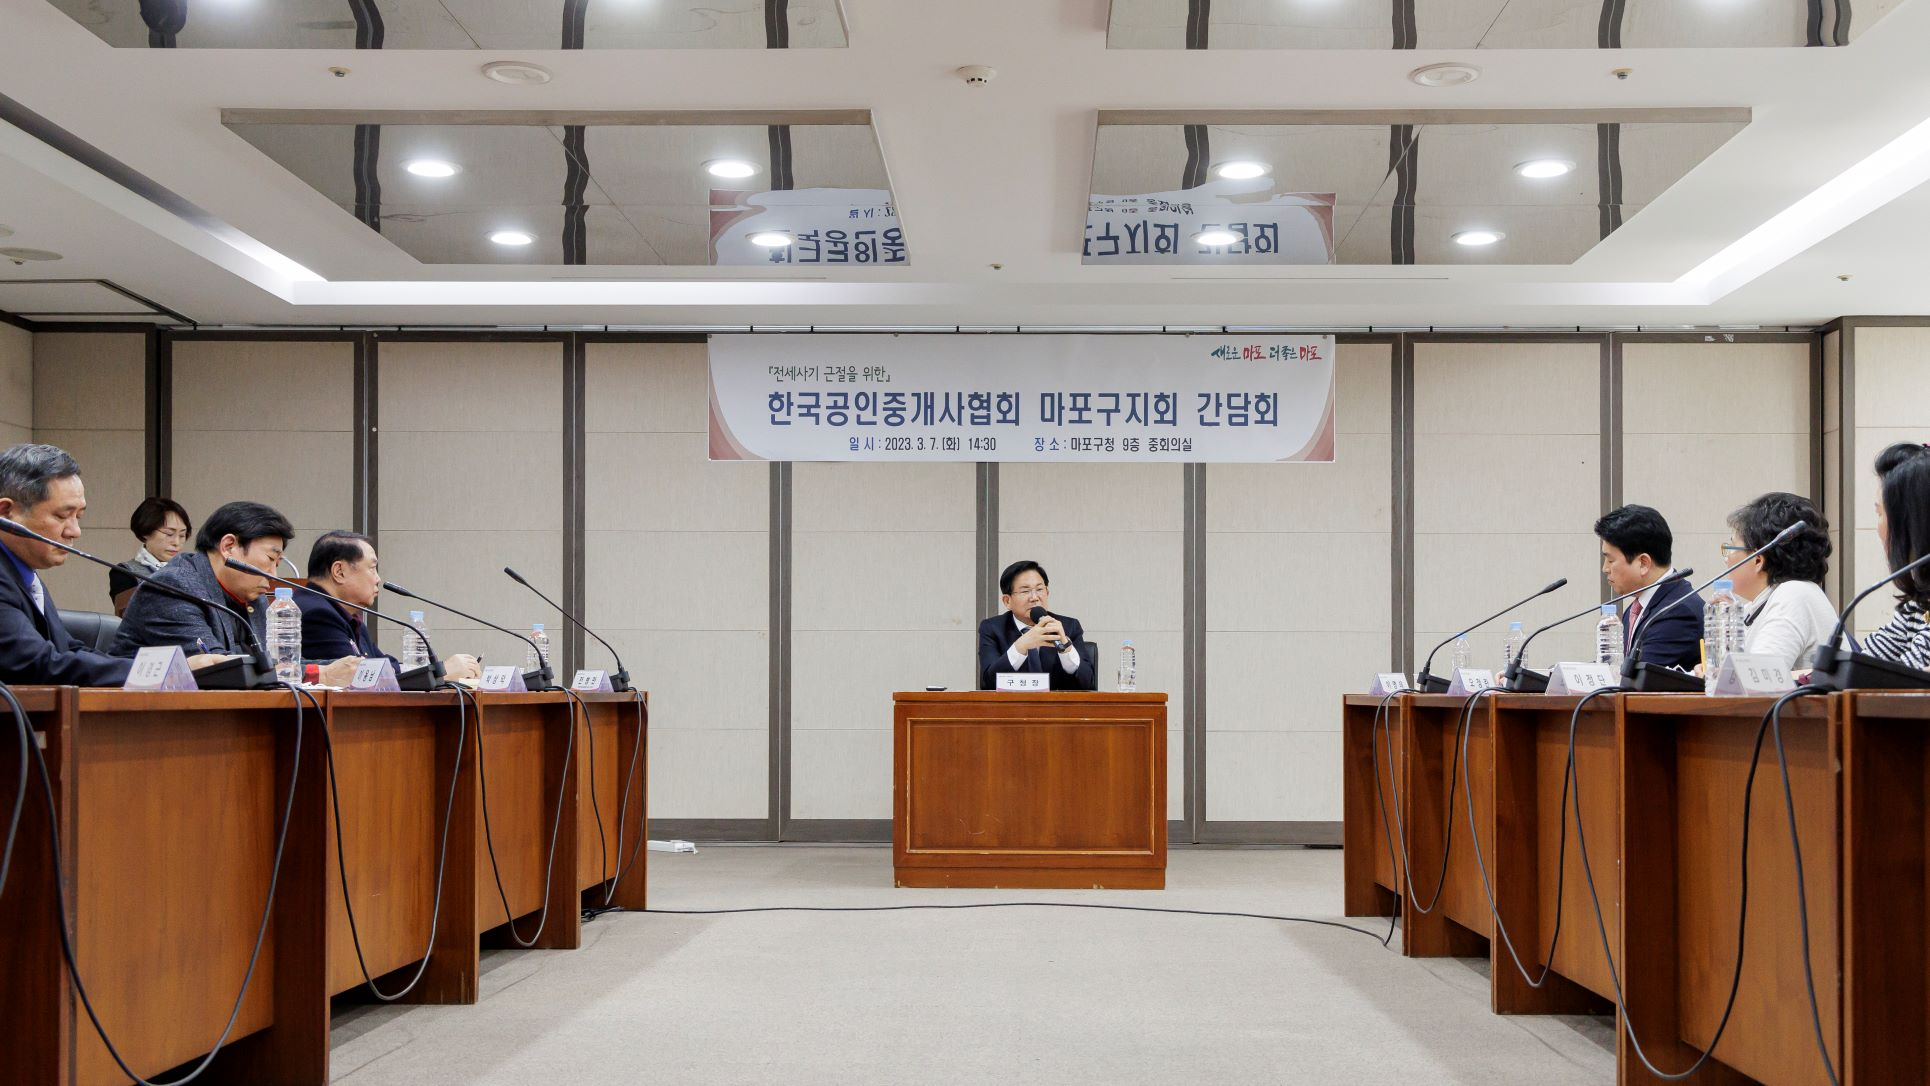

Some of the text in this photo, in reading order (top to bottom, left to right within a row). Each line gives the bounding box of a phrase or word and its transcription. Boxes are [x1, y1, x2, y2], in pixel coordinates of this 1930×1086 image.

[1243, 345, 1266, 361] 마포
[1269, 345, 1280, 361] 더
[1281, 345, 1298, 361] 좋은
[1300, 345, 1322, 361] 마포
[824, 366, 858, 382] 근절을
[768, 391, 1278, 427] 한국공인중개사협회 마포구지회 간담회
[968, 437, 997, 451] 14:30
[1071, 437, 1115, 452] 마포구청
[1123, 437, 1140, 452] 9층
[1148, 437, 1193, 452] 중회의실
